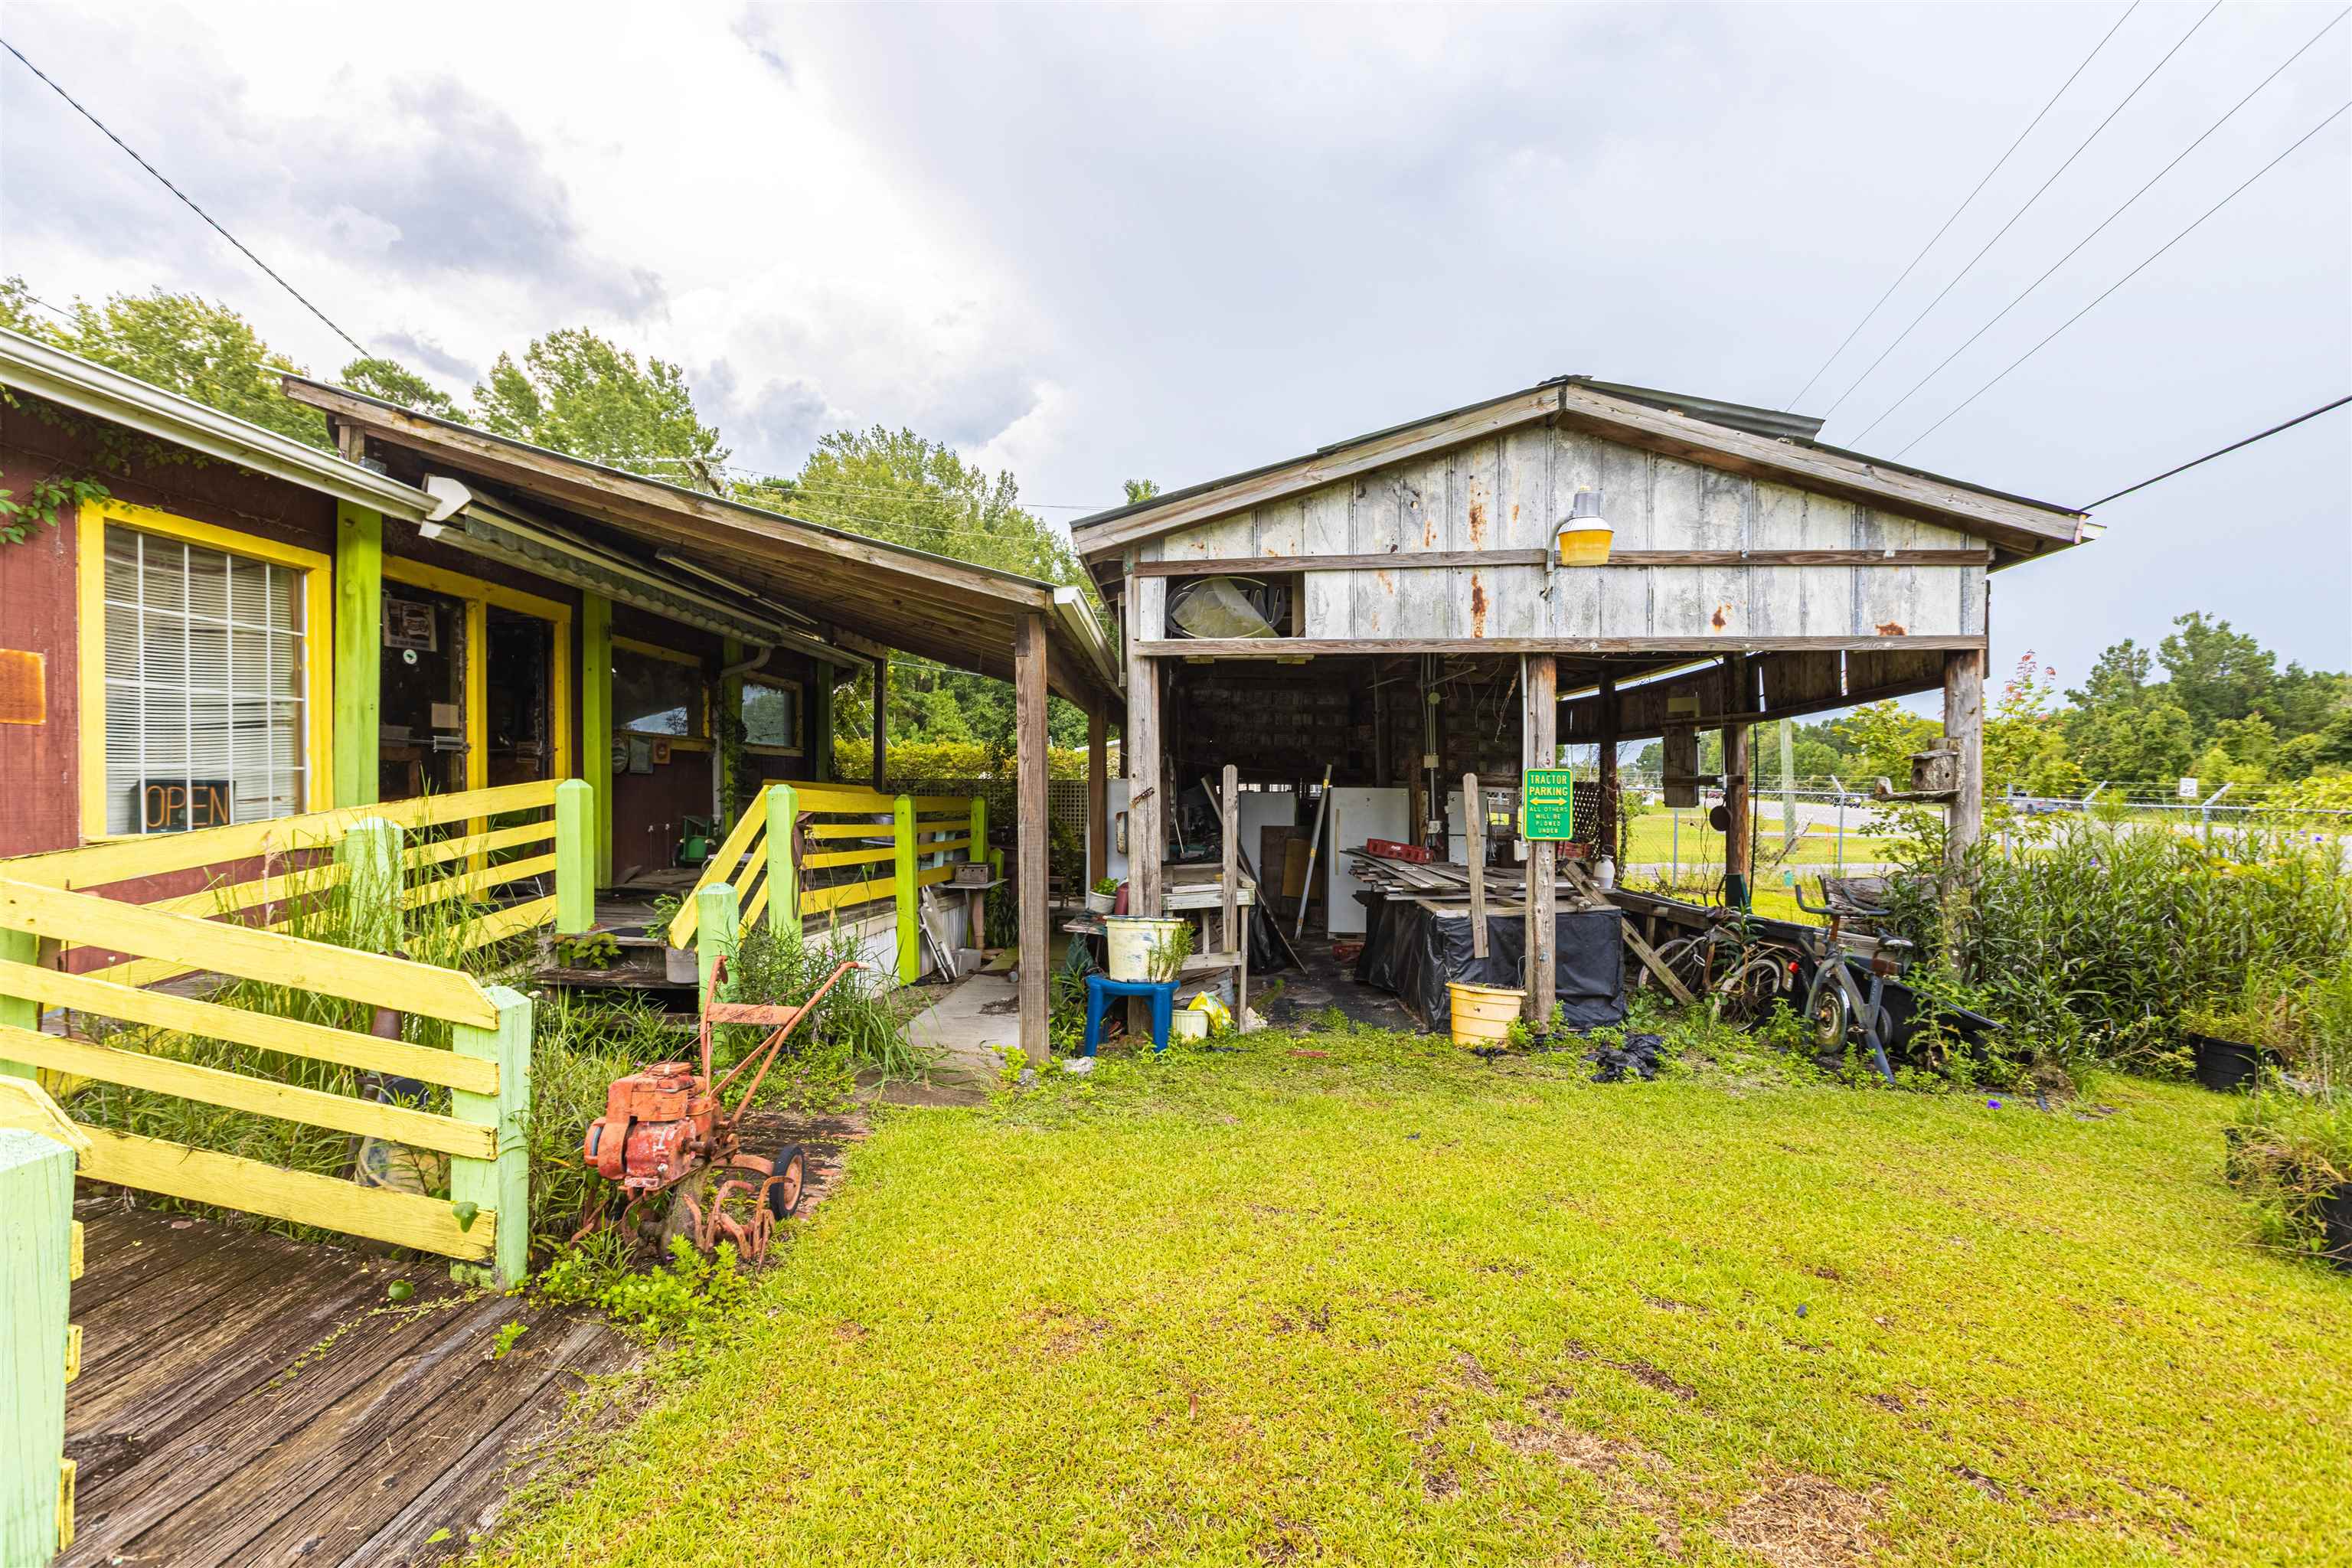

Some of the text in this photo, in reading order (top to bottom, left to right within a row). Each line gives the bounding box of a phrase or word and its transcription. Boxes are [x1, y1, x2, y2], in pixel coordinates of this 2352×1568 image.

[1530, 775, 1567, 785] TRACTOR
[1529, 786, 1569, 796] PARKING
[145, 785, 229, 828] OPEN
